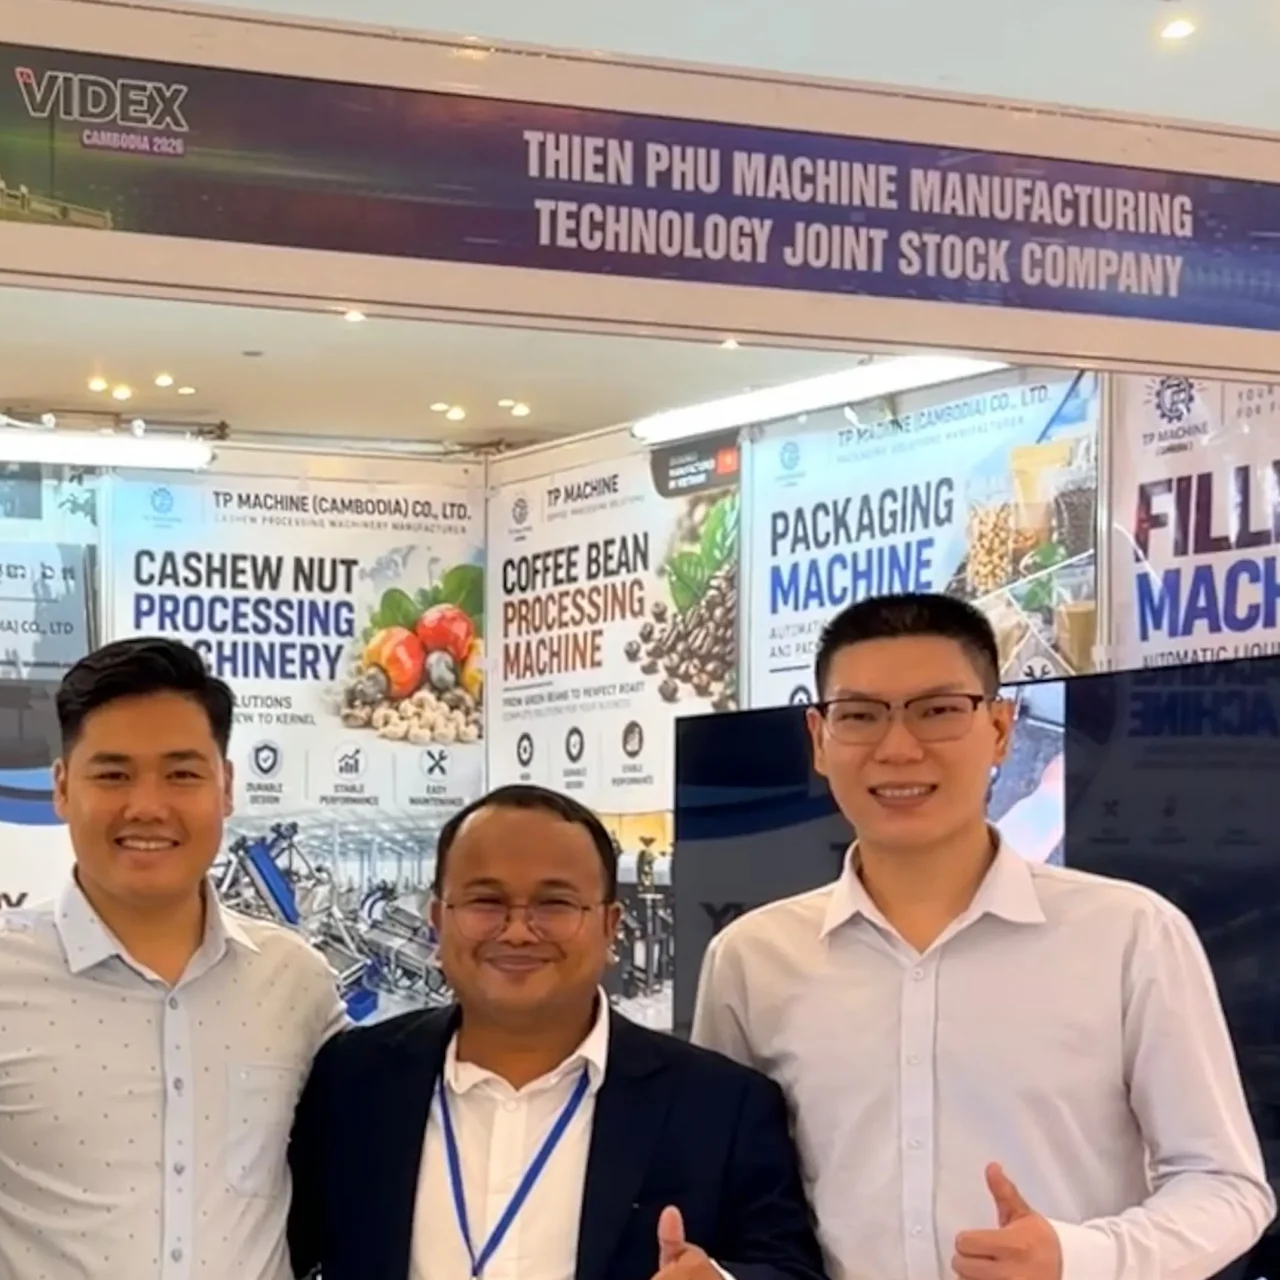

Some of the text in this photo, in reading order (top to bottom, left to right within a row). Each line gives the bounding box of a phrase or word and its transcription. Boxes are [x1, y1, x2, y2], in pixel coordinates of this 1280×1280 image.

[15, 66, 189, 132] VIDEX
[82, 129, 150, 151] CAMBODIA
[523, 131, 1194, 238] THIEN PHU MACHINE MANUFACTURING
[534, 198, 1185, 299] TECHNOLOGY JOINT STOCK COMPANY
[212, 491, 234, 508] TP
[237, 492, 310, 513] MACHINE
[312, 494, 409, 518] (CAMBODIA)
[442, 502, 472, 520] LTD.
[546, 474, 619, 507] TP MACHINE
[771, 477, 954, 557] PACKAGING
[1134, 460, 1280, 564] FILL
[134, 549, 359, 594] CASHEW NUT
[503, 531, 650, 596] COFFEE BEAN
[770, 537, 935, 615] MACHINE
[50, 621, 74, 635] LTD
[133, 592, 355, 638] PROCESSING
[503, 577, 646, 639] PROCESSING
[192, 638, 345, 681] CHINERY
[503, 629, 604, 682] MACHINE
